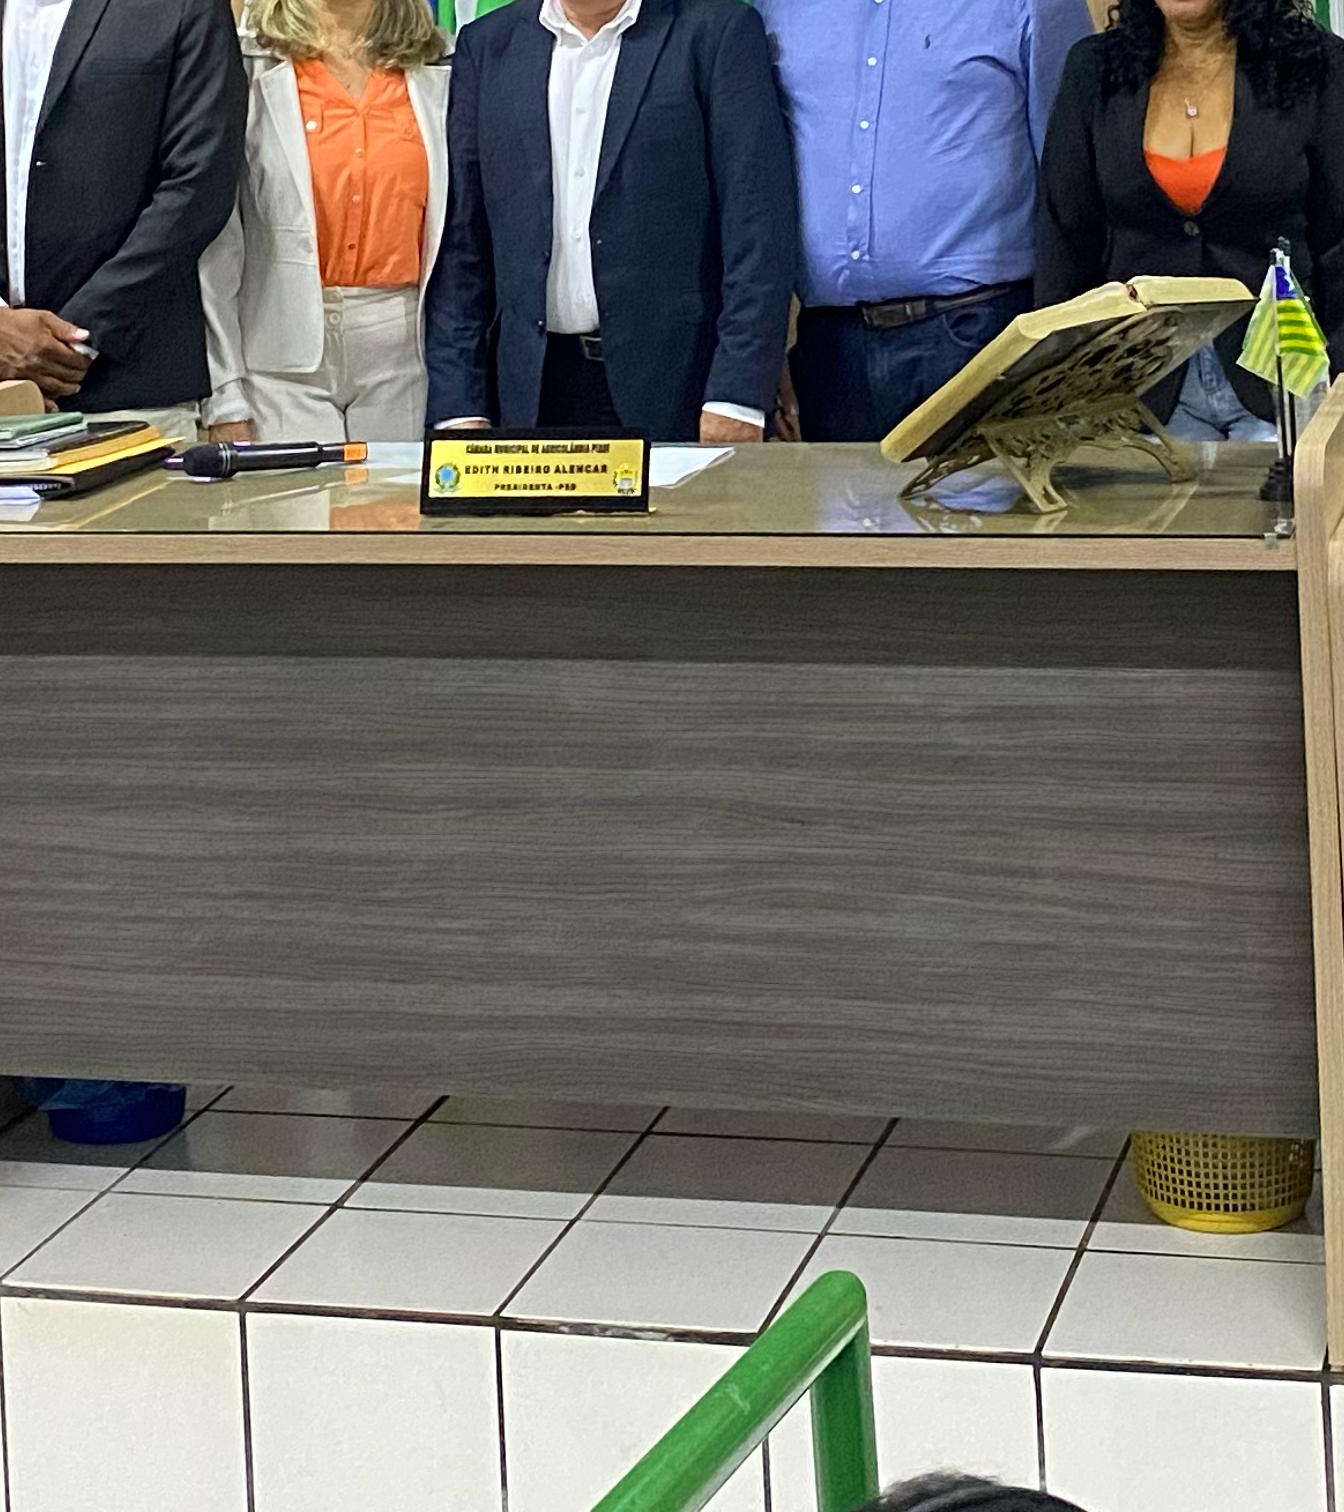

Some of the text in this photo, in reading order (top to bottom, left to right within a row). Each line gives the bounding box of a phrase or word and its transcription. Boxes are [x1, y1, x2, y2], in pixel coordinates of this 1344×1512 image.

[465, 464, 608, 474] EDITH RIBEIRO ALENCAR
